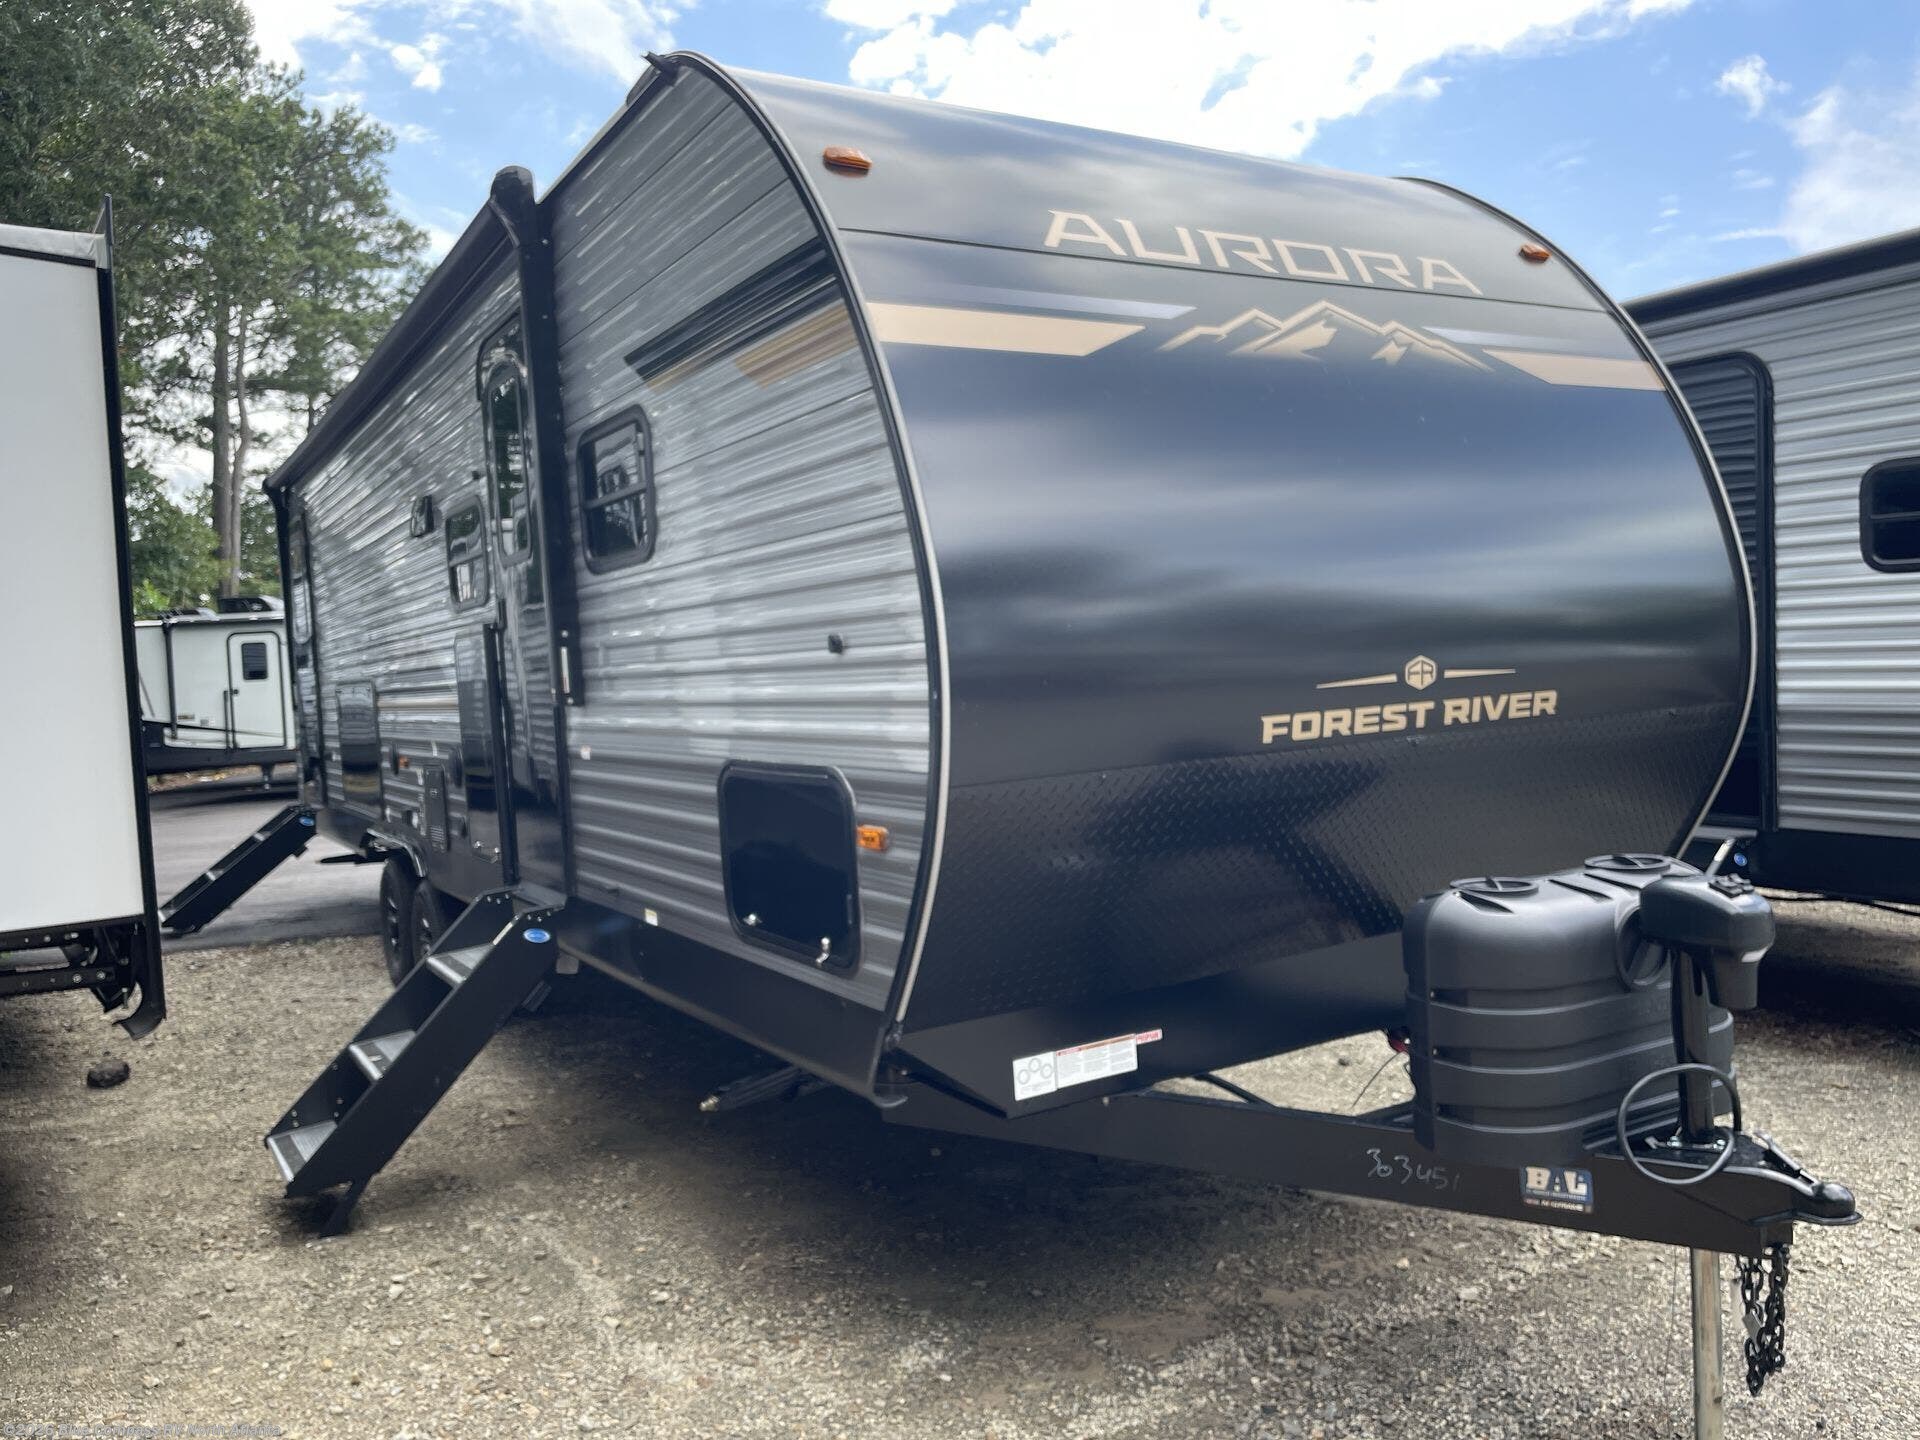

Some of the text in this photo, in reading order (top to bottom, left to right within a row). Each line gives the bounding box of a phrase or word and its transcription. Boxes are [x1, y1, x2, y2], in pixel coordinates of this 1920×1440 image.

[1043, 209, 1483, 296] AURORA
[1261, 689, 1558, 744] FOREST RIVER
